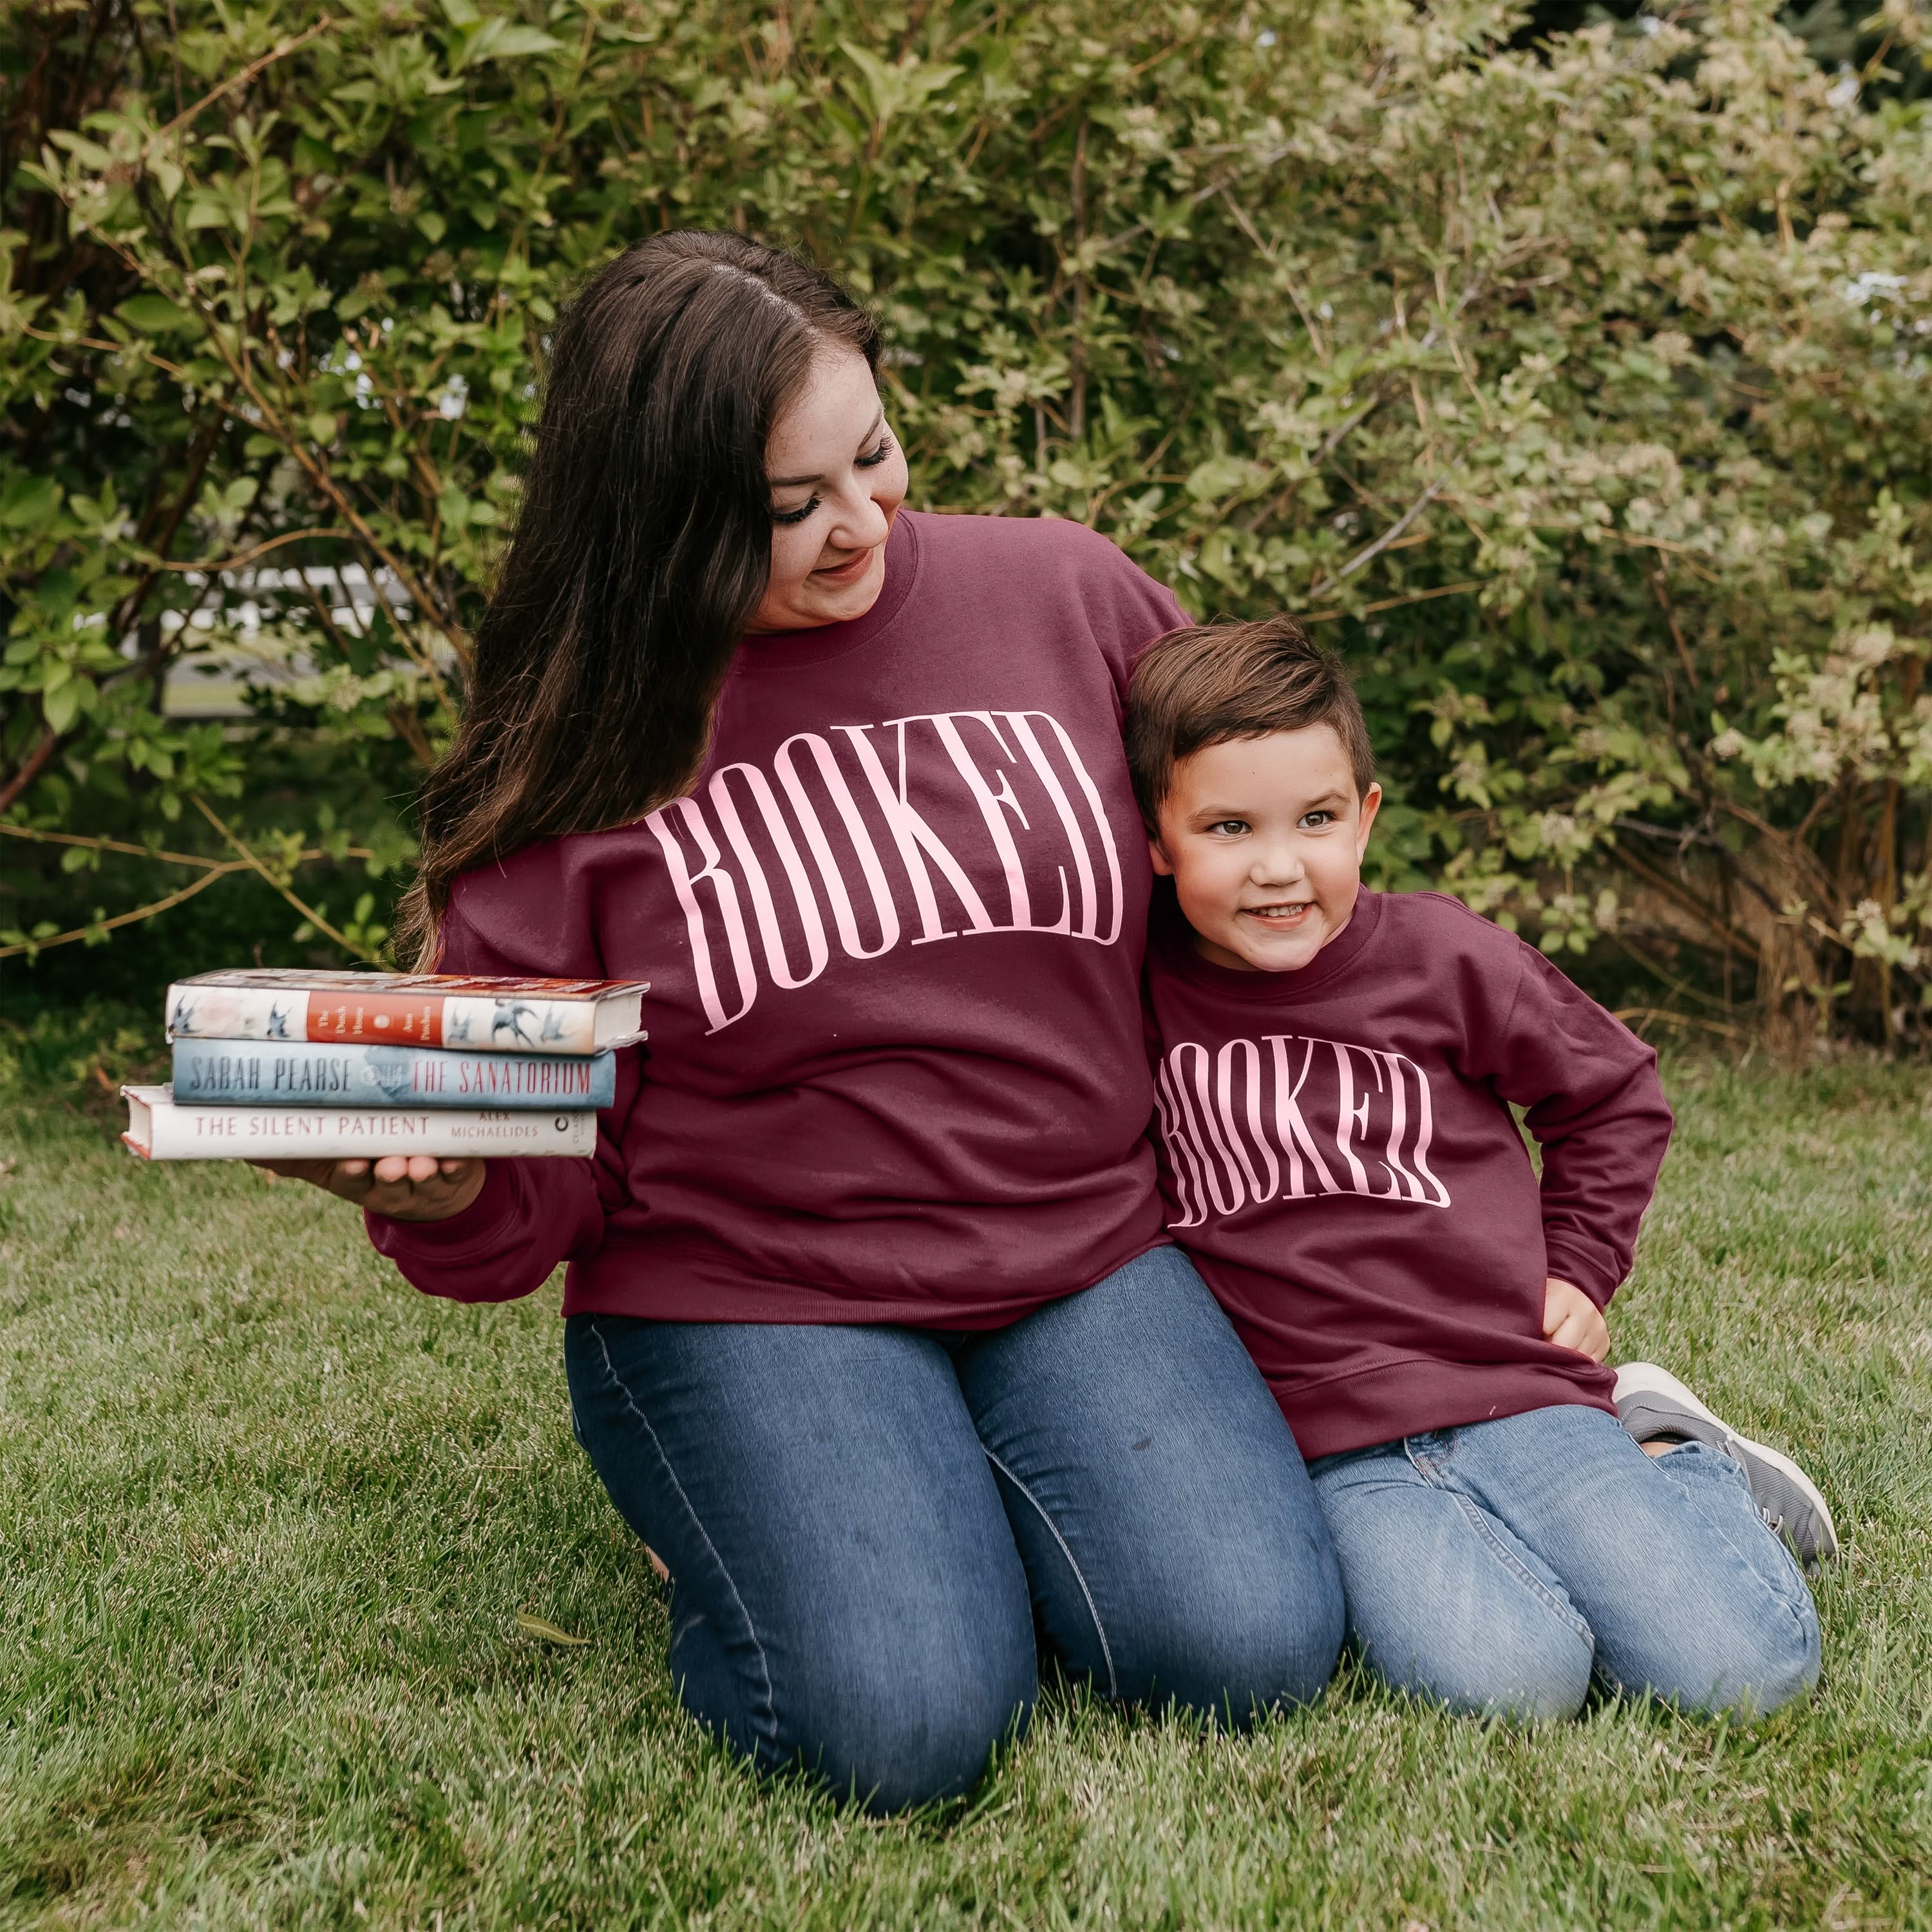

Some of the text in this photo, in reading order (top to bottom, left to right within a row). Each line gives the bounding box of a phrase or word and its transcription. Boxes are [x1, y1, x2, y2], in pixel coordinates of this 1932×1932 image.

[633, 710, 1123, 1036] BOOKED
[190, 1056, 261, 1090] SARAH
[273, 1057, 353, 1092] PEARSE
[412, 1061, 449, 1092] THE
[459, 1061, 591, 1094] SANATORIUM
[196, 1116, 430, 1135] THE SILENT PATIENT
[451, 1126, 538, 1138] MICHAELIDES
[479, 1112, 510, 1121] ALEX
[1153, 1035, 1452, 1228] BOOKED
